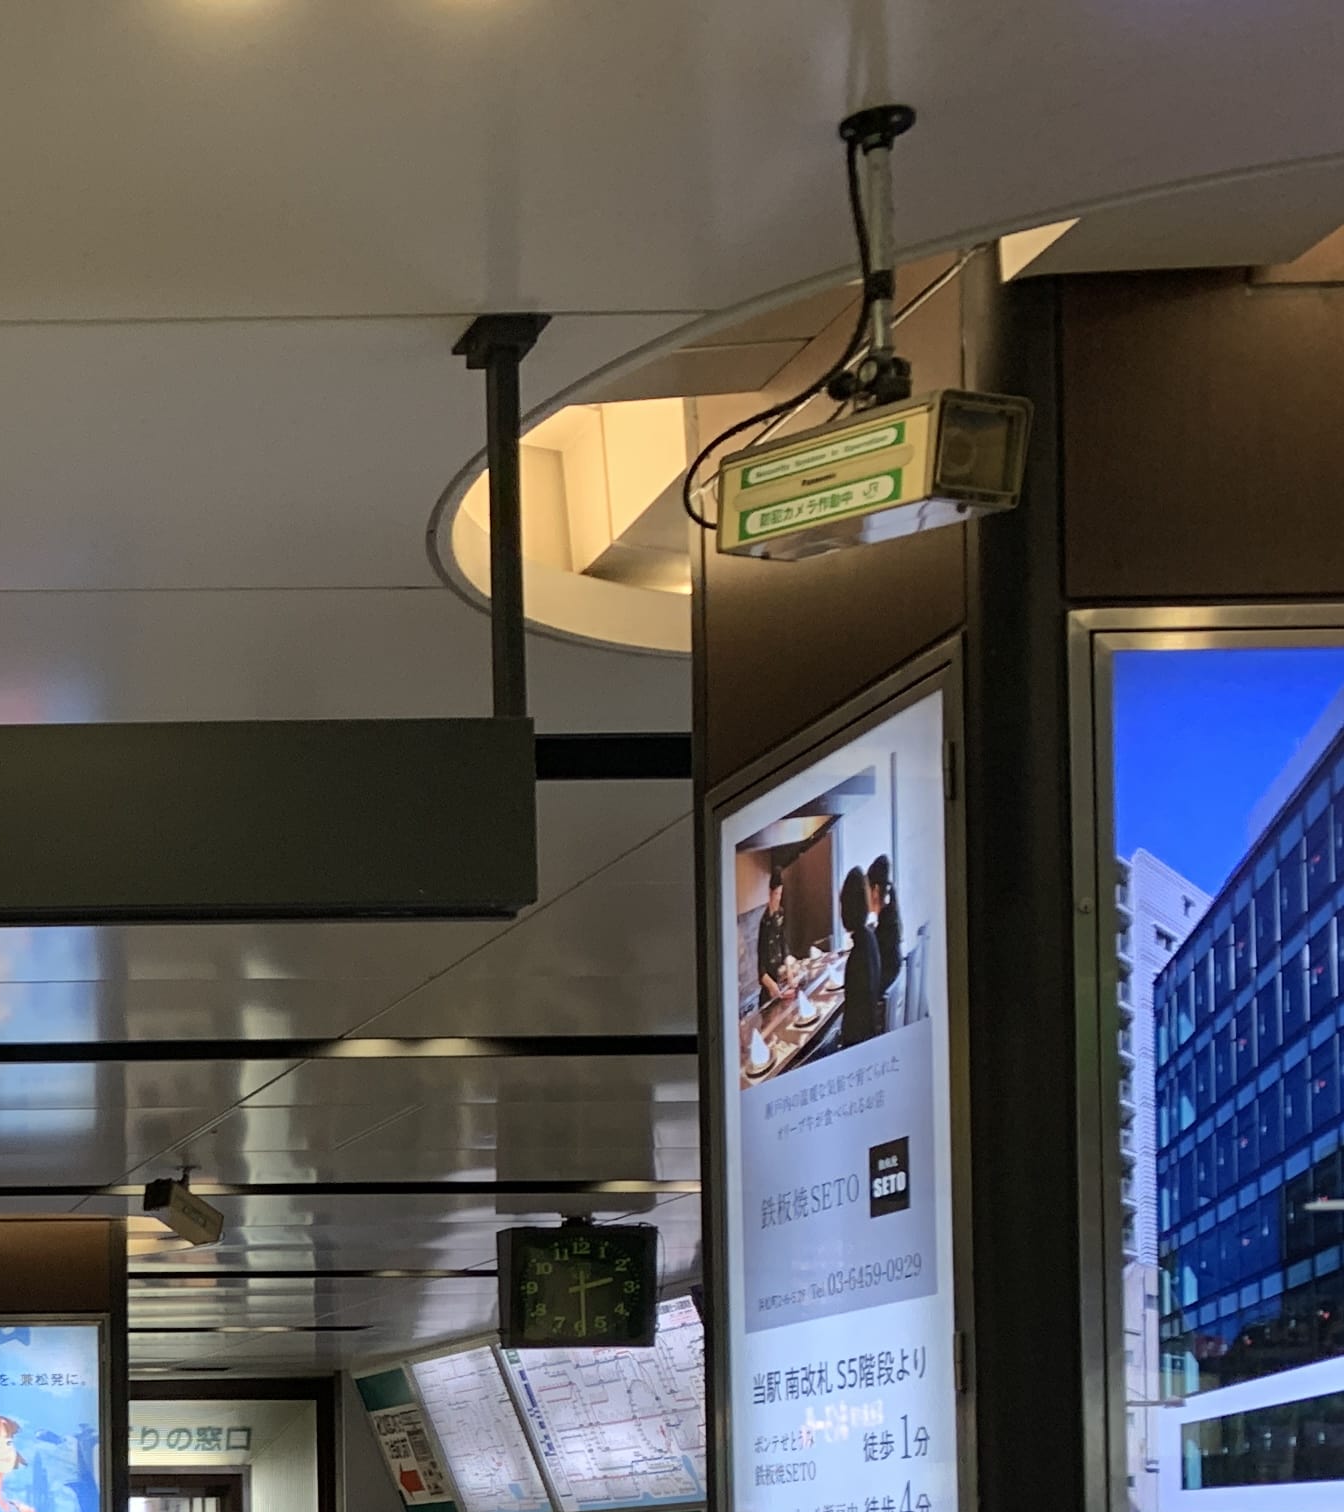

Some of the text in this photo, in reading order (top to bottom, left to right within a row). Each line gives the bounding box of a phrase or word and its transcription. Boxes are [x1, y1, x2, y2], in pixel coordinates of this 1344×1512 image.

[873, 1172, 906, 1198] SETO
[761, 1174, 861, 1229] 鉄板焼SETO
[571, 1241, 591, 1255] 12
[535, 1262, 553, 1275] 10
[615, 1258, 628, 1272] 2
[827, 1253, 922, 1295] 03-6459-0929
[525, 1281, 539, 1294] 9
[623, 1281, 635, 1294] 3
[534, 1303, 547, 1316] 8
[614, 1303, 626, 1315] 4
[554, 1316, 566, 1329] 7
[594, 1316, 607, 1329] 5
[753, 1346, 926, 1405] 当駅 南改札 S5階段より
[128, 1425, 252, 1452] りの窓口
[864, 1414, 930, 1462] 徒歩1分
[755, 1460, 816, 1486] 鉄板焼SETO
